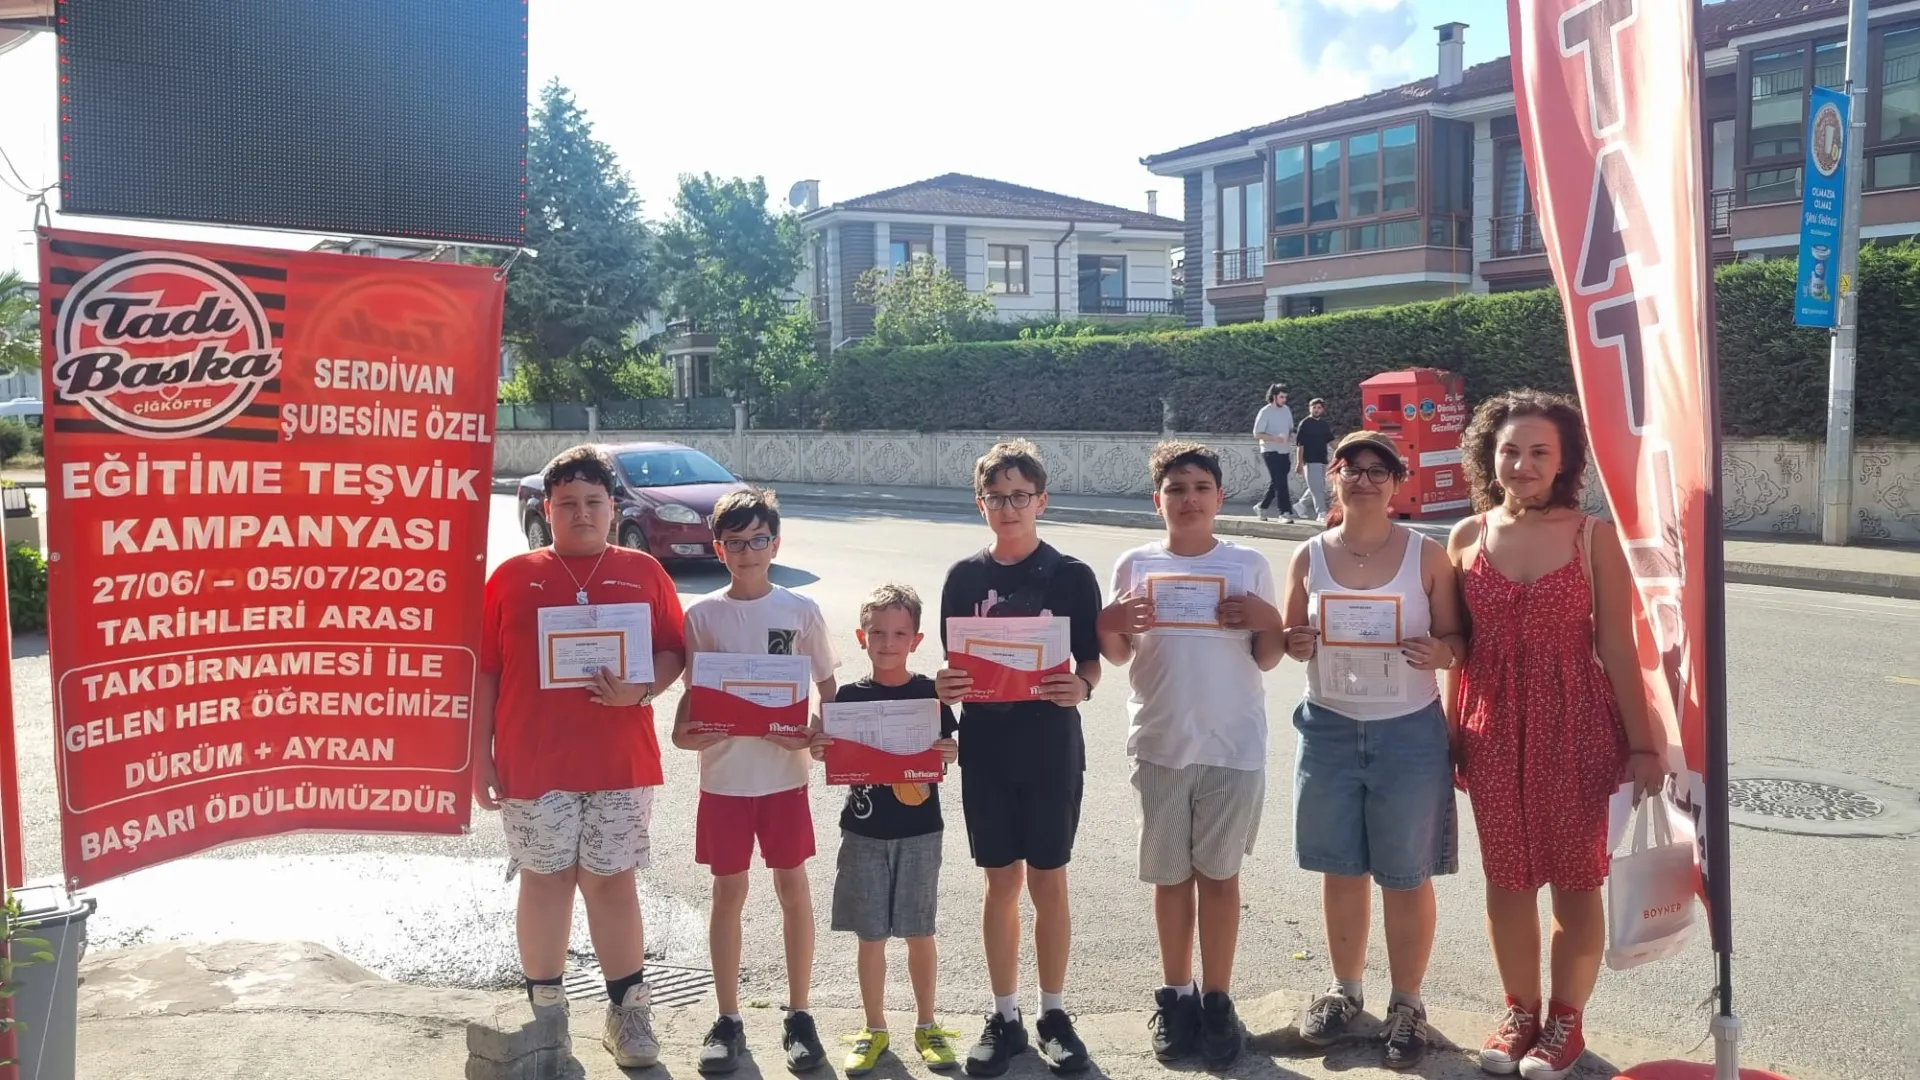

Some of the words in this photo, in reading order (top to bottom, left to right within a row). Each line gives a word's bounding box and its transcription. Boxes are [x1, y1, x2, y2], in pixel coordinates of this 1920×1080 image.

[313, 355, 455, 396] SERDİVAN
[281, 401, 418, 442] ŞUBESİNE
[425, 404, 492, 444] ÖZEL
[61, 452, 282, 500] EĞİTİME
[299, 459, 481, 504] TEŞVİK
[101, 515, 452, 556] KAMPANYASI
[92, 569, 206, 605] 27/06/
[247, 565, 448, 594] 05/07/2026
[97, 600, 306, 647] TARİHLERİ
[319, 605, 433, 632] ARASI
[81, 647, 374, 703] TAKDİRNAMESİ
[386, 647, 444, 679] İLE
[65, 707, 165, 754] GELEN
[175, 695, 241, 731] HER
[251, 685, 470, 721] ÖĞRENCİMİZE
[125, 740, 243, 790] DÜRÜM
[254, 743, 273, 762] +
[282, 736, 395, 762] AYRAN
[80, 804, 196, 862] BAŞARI
[204, 782, 456, 826] ÖDÜLÜMÜZDÜR
[1643, 903, 1682, 920] BOYNER
